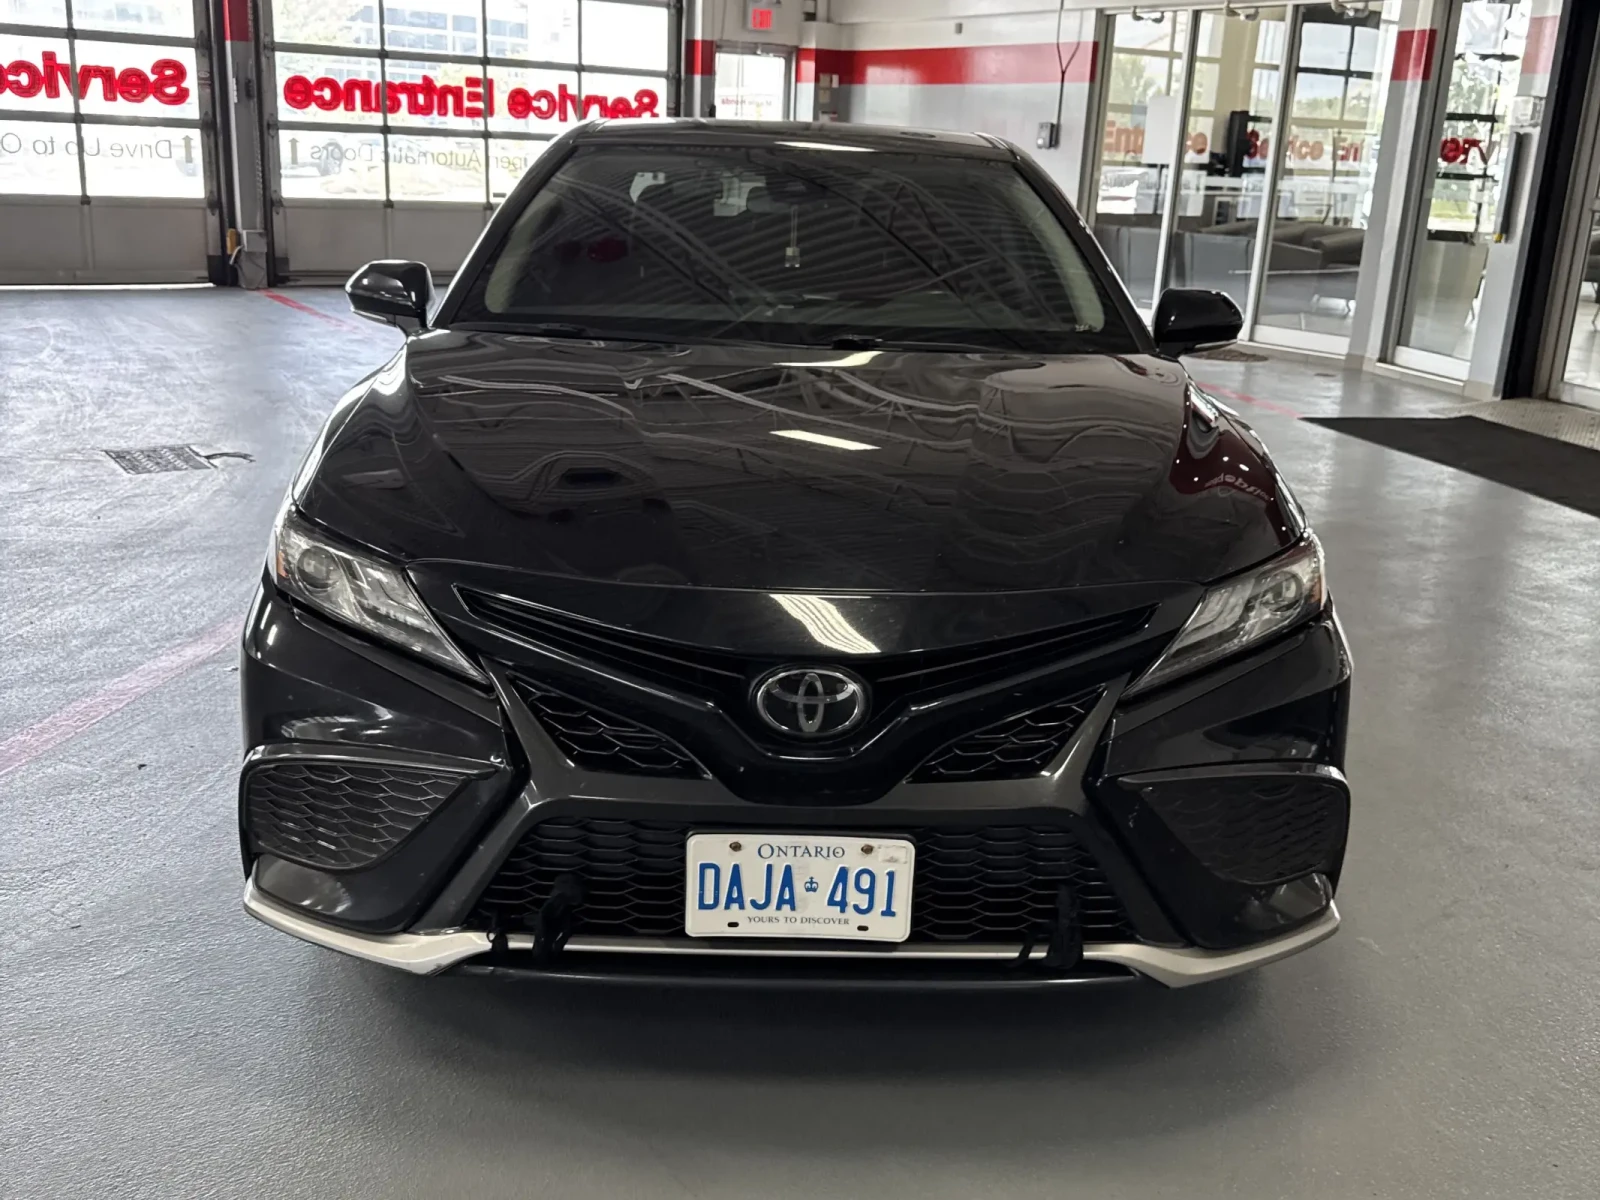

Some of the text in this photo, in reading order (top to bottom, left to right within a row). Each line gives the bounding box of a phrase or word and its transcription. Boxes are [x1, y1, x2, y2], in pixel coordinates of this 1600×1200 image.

[697, 862, 897, 917] DAJA 491
[746, 915, 850, 925] YOURS TO DISCOVER
